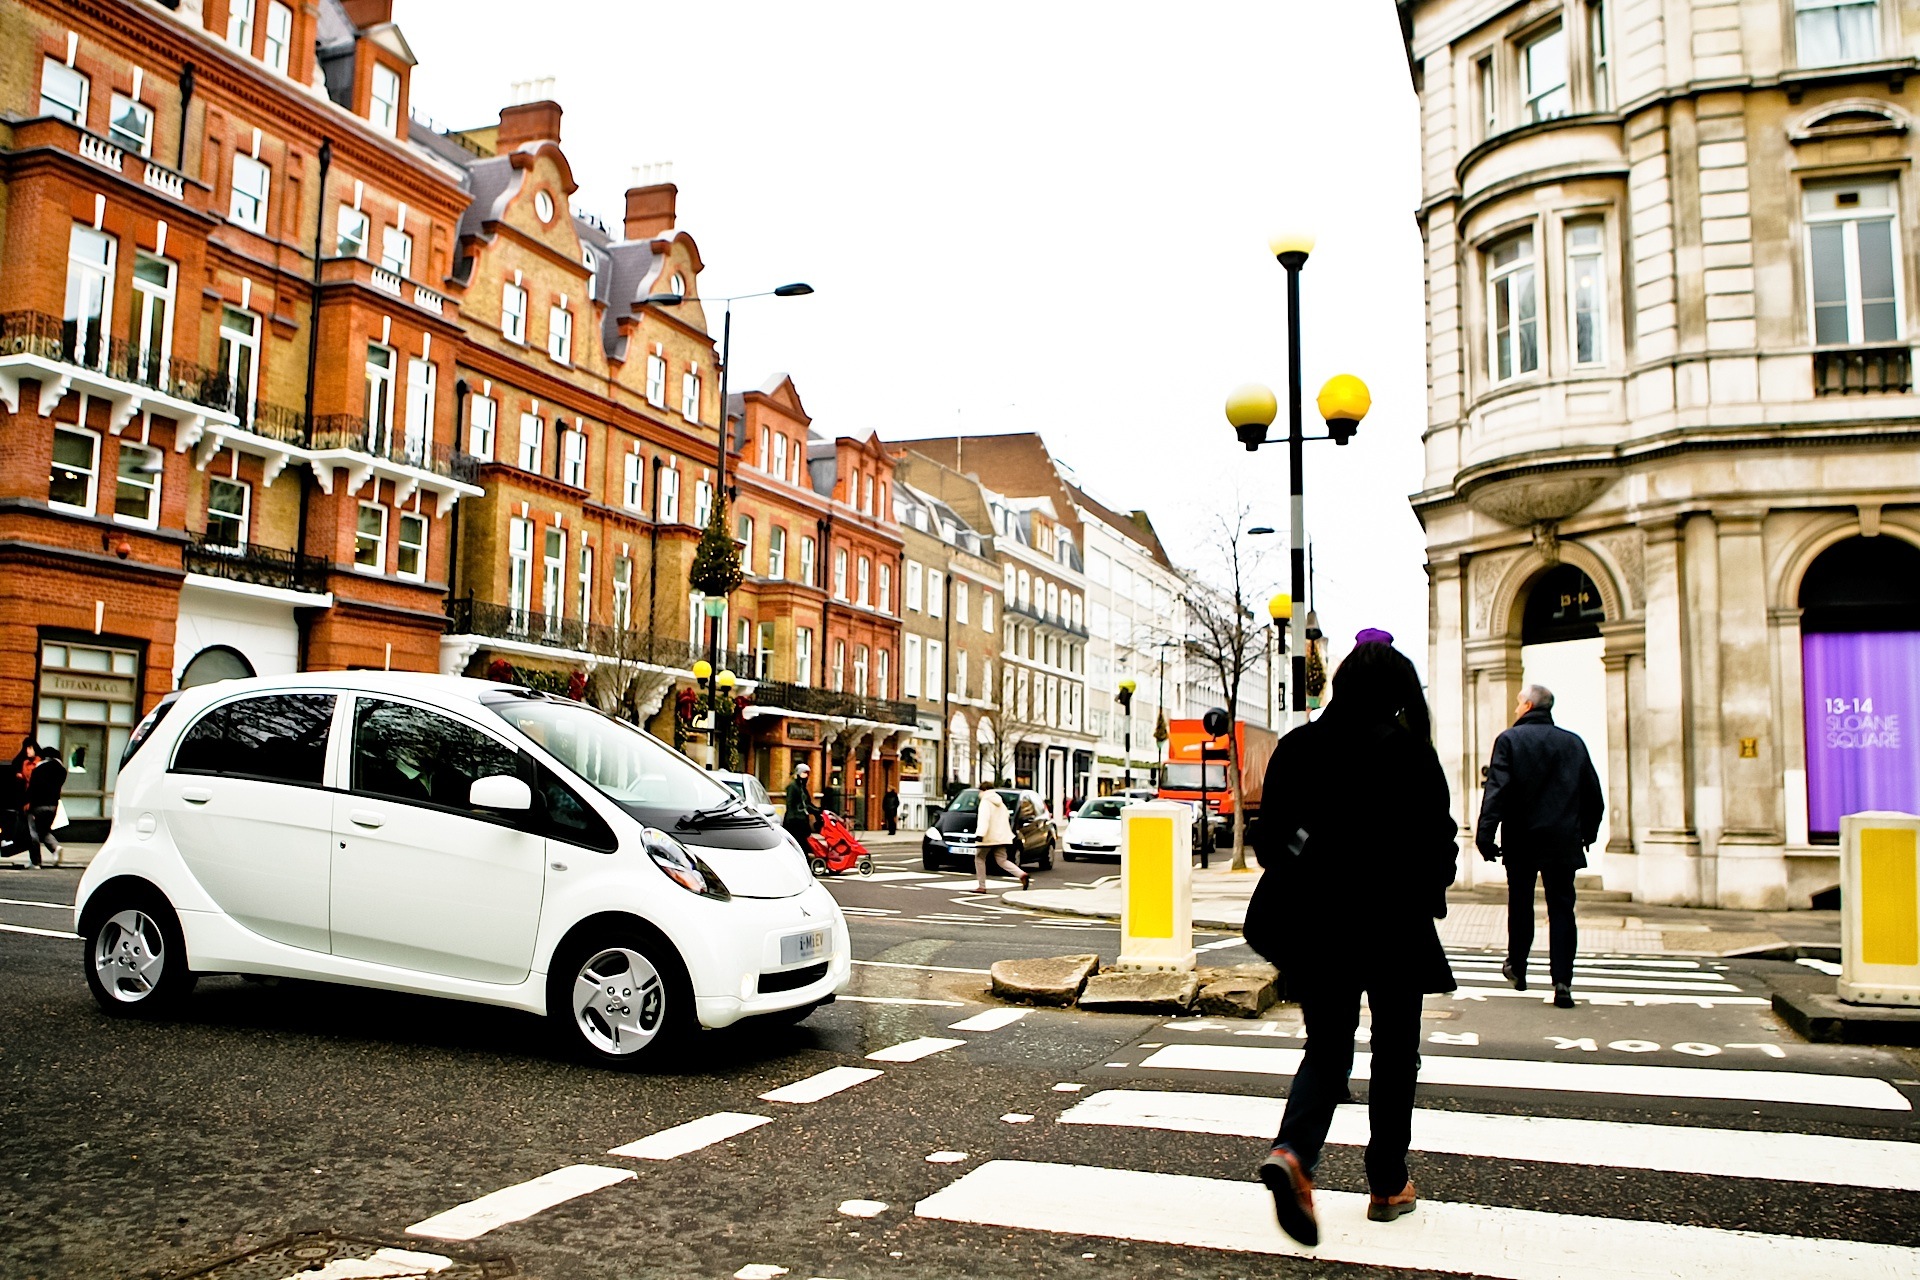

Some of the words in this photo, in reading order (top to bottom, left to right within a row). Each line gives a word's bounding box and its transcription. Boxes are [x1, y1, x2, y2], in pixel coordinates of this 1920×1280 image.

[1825, 697, 1873, 714] 13-14
[1826, 714, 1899, 732] SLOANE
[1826, 731, 1900, 749] SQUARE
[1544, 1037, 1787, 1059] LOOK
